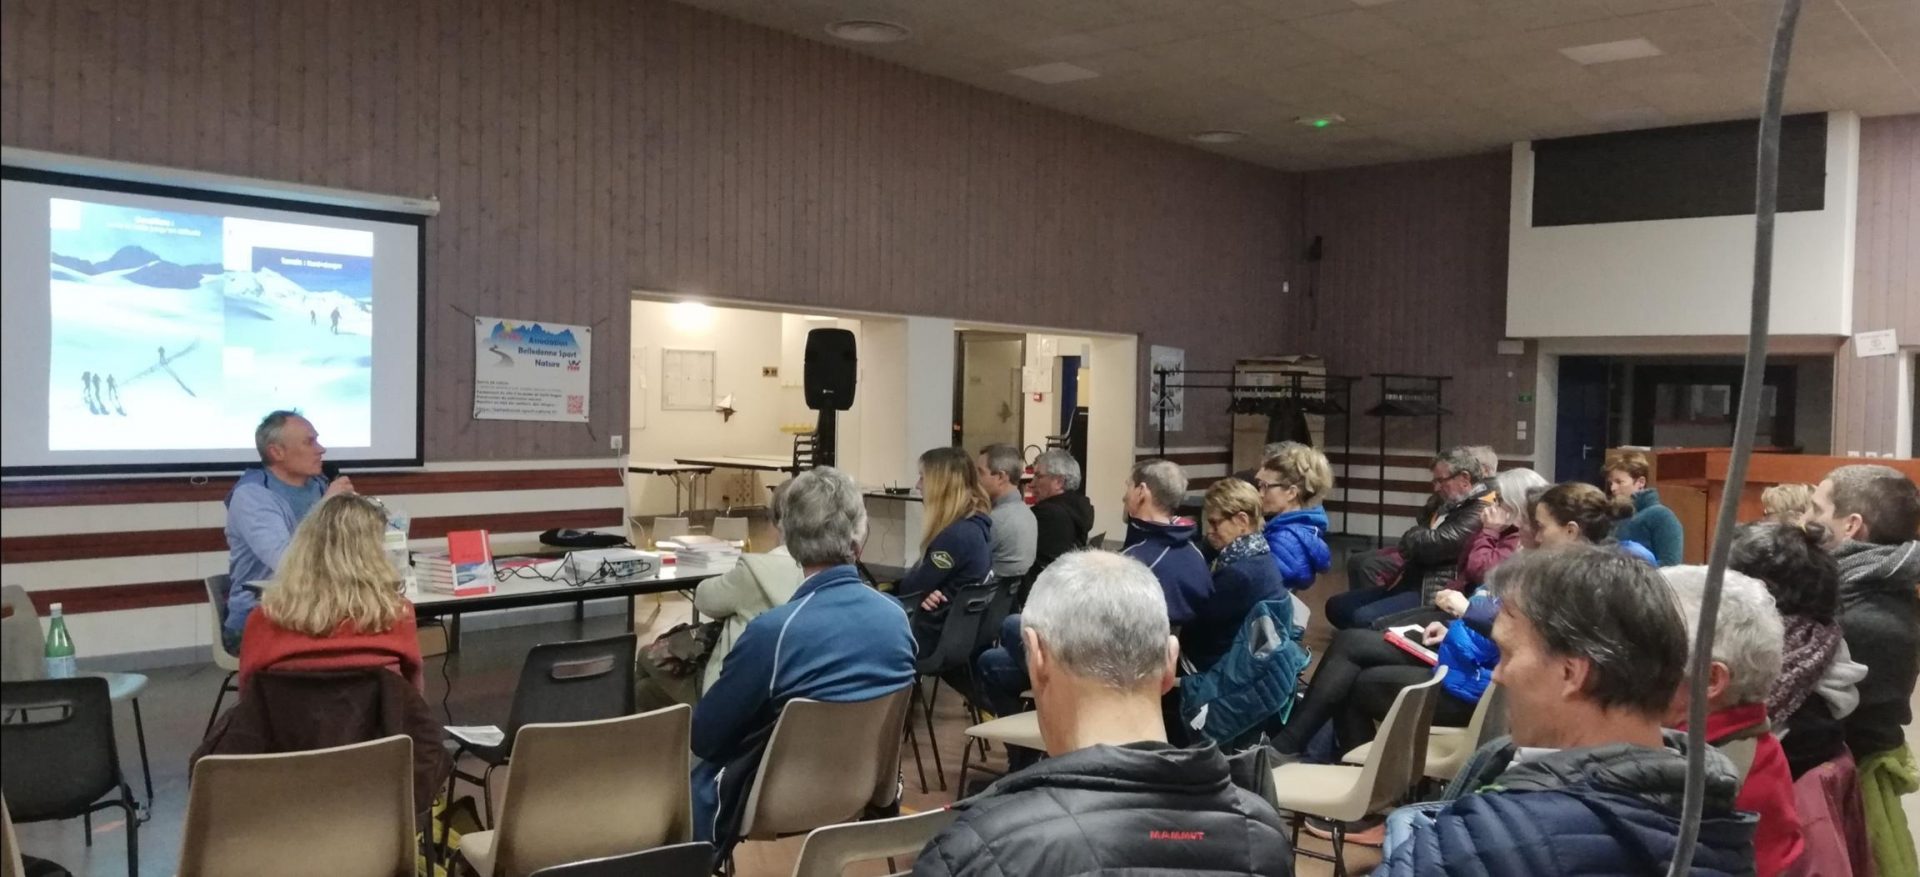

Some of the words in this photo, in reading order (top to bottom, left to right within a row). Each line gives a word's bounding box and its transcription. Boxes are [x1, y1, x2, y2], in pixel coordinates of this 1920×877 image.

[559, 350, 577, 358] Sport
[535, 359, 560, 368] Nature
[1149, 830, 1205, 840] MAMMUT
